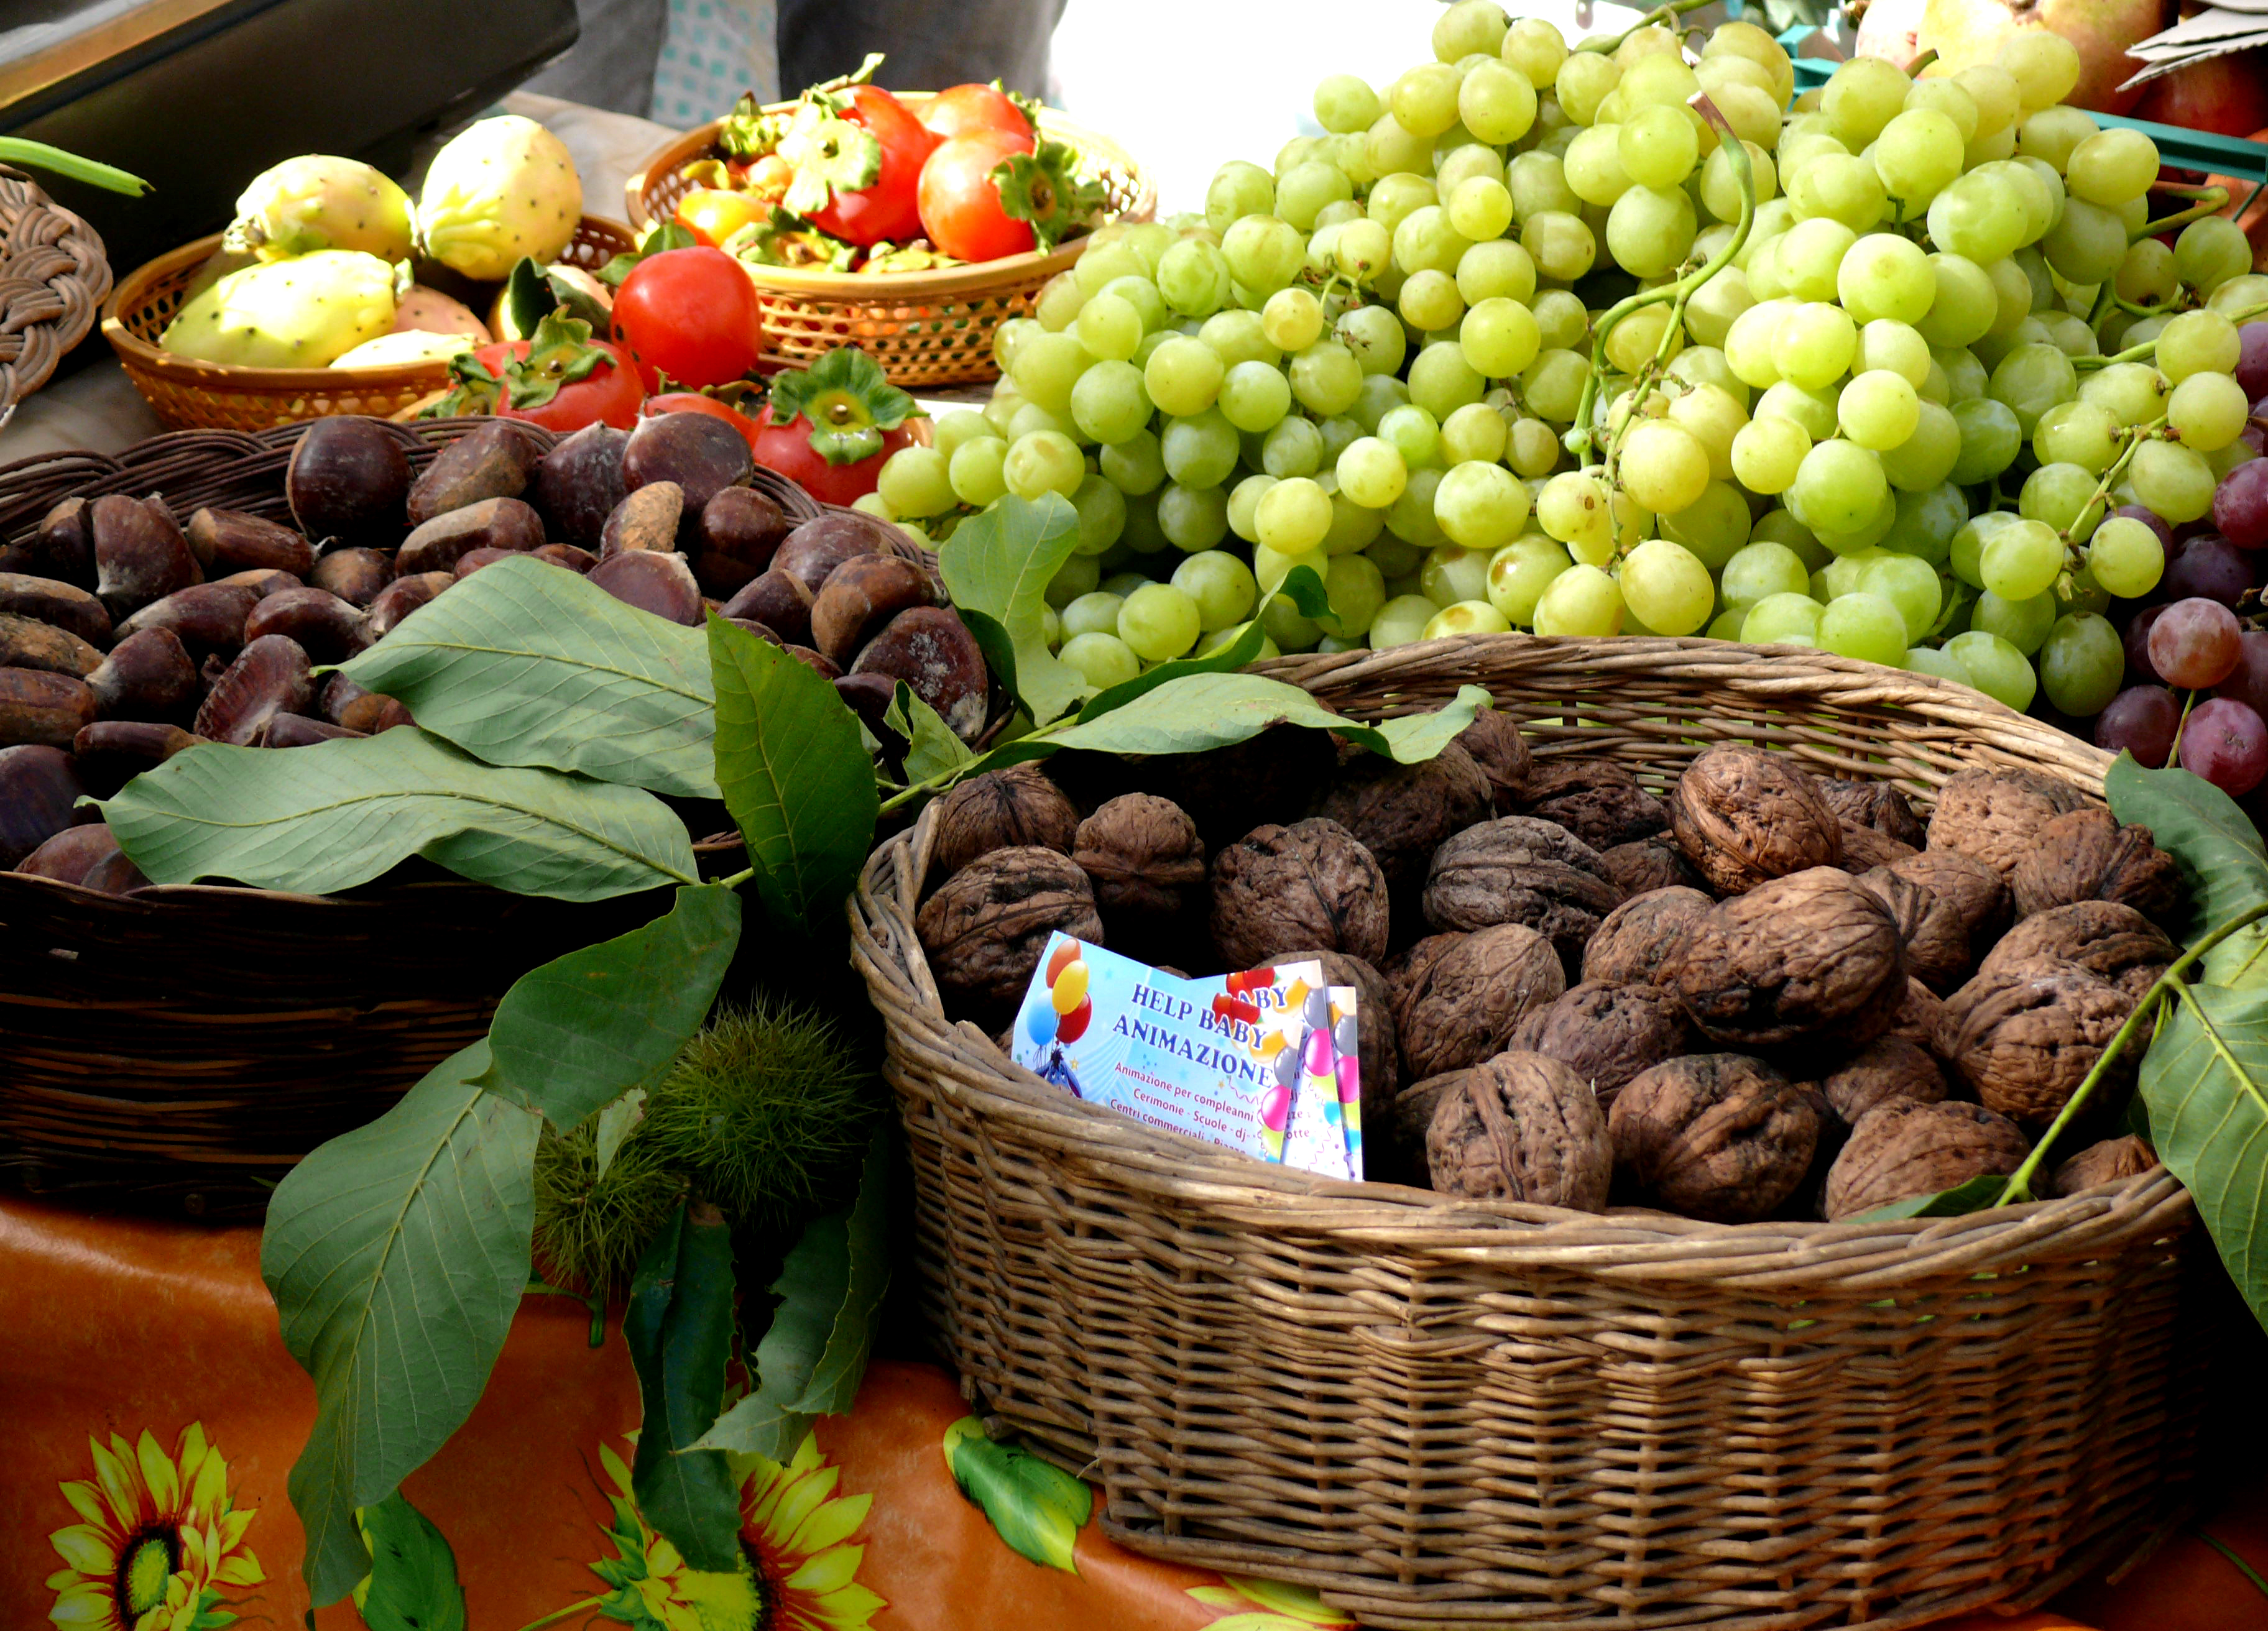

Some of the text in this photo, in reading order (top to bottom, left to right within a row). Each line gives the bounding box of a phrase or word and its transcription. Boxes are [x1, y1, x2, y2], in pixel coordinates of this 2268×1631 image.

[1132, 983, 1268, 1049] HELP BABY
[1113, 1014, 1273, 1088] ANIMAZIONE
[1110, 1099, 1140, 1119] Centri
[1143, 1113, 1204, 1141] commerciali
[1115, 1062, 1254, 1122] Animazione per compleanni
[1134, 1088, 1184, 1116] Cerimonie
[1194, 1111, 1227, 1132] Scuole
